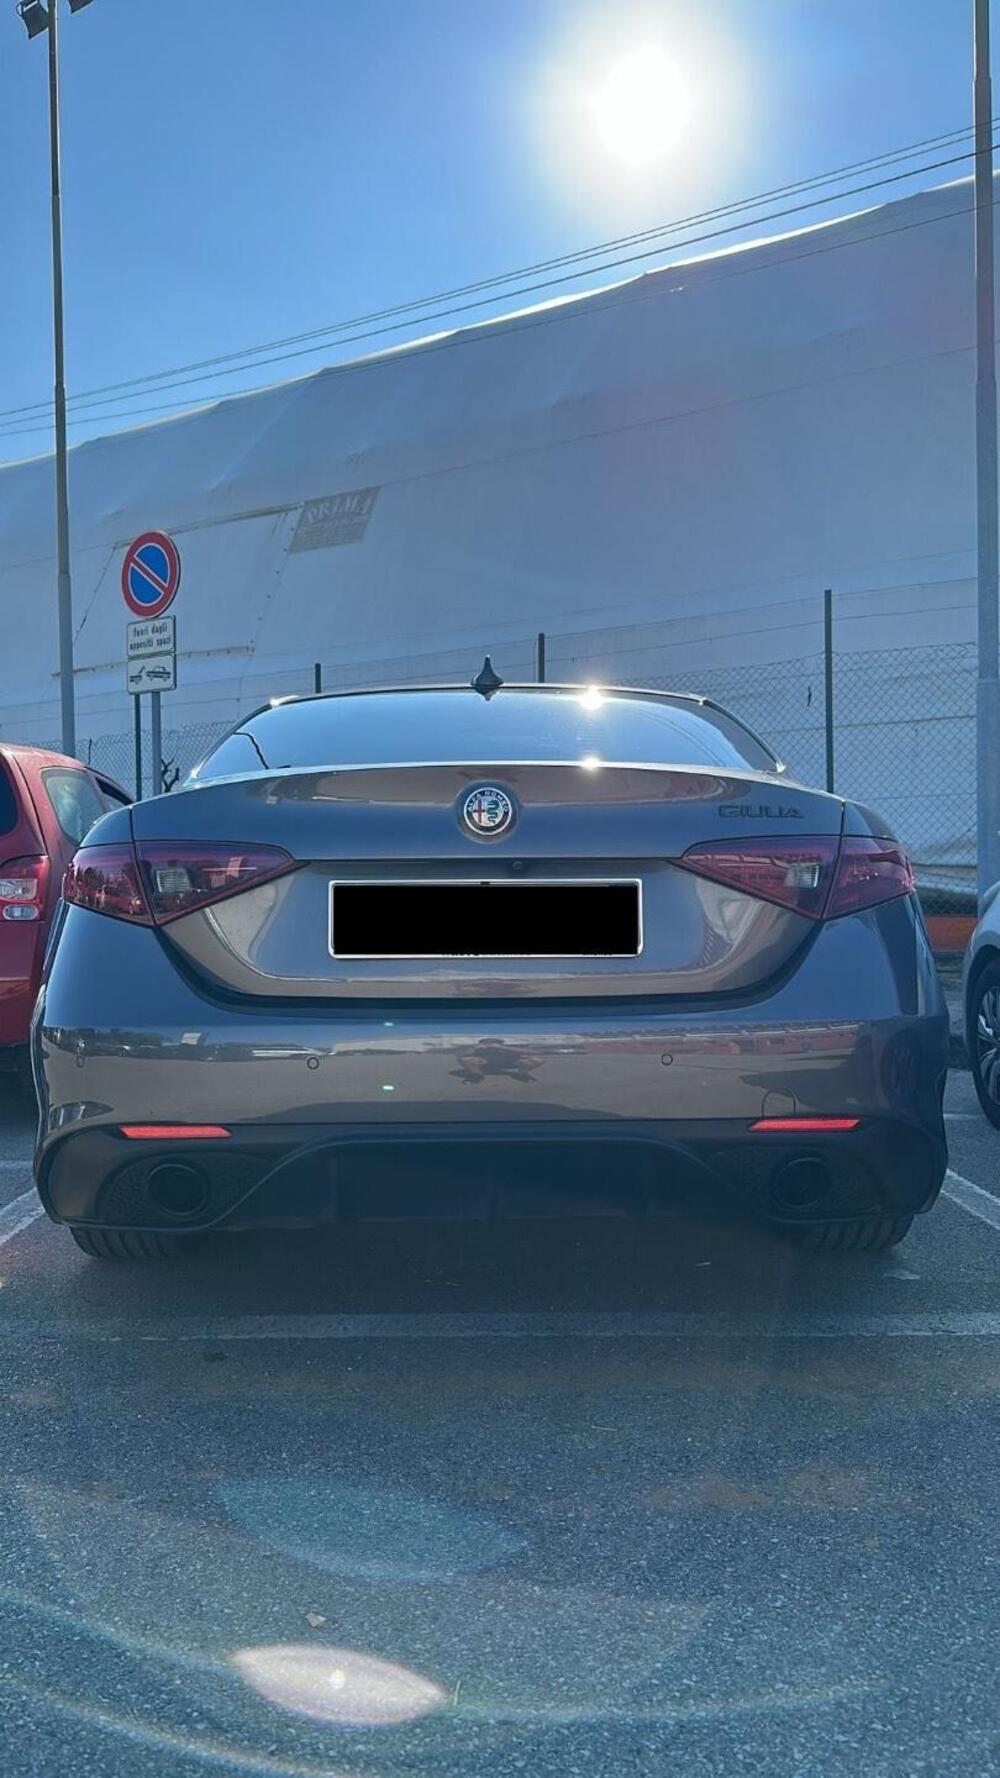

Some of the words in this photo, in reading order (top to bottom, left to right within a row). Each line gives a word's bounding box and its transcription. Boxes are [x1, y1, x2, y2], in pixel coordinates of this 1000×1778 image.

[467, 793, 482, 812] ALFA
[484, 790, 509, 812] ROMEO
[718, 804, 806, 819] GIULIA
